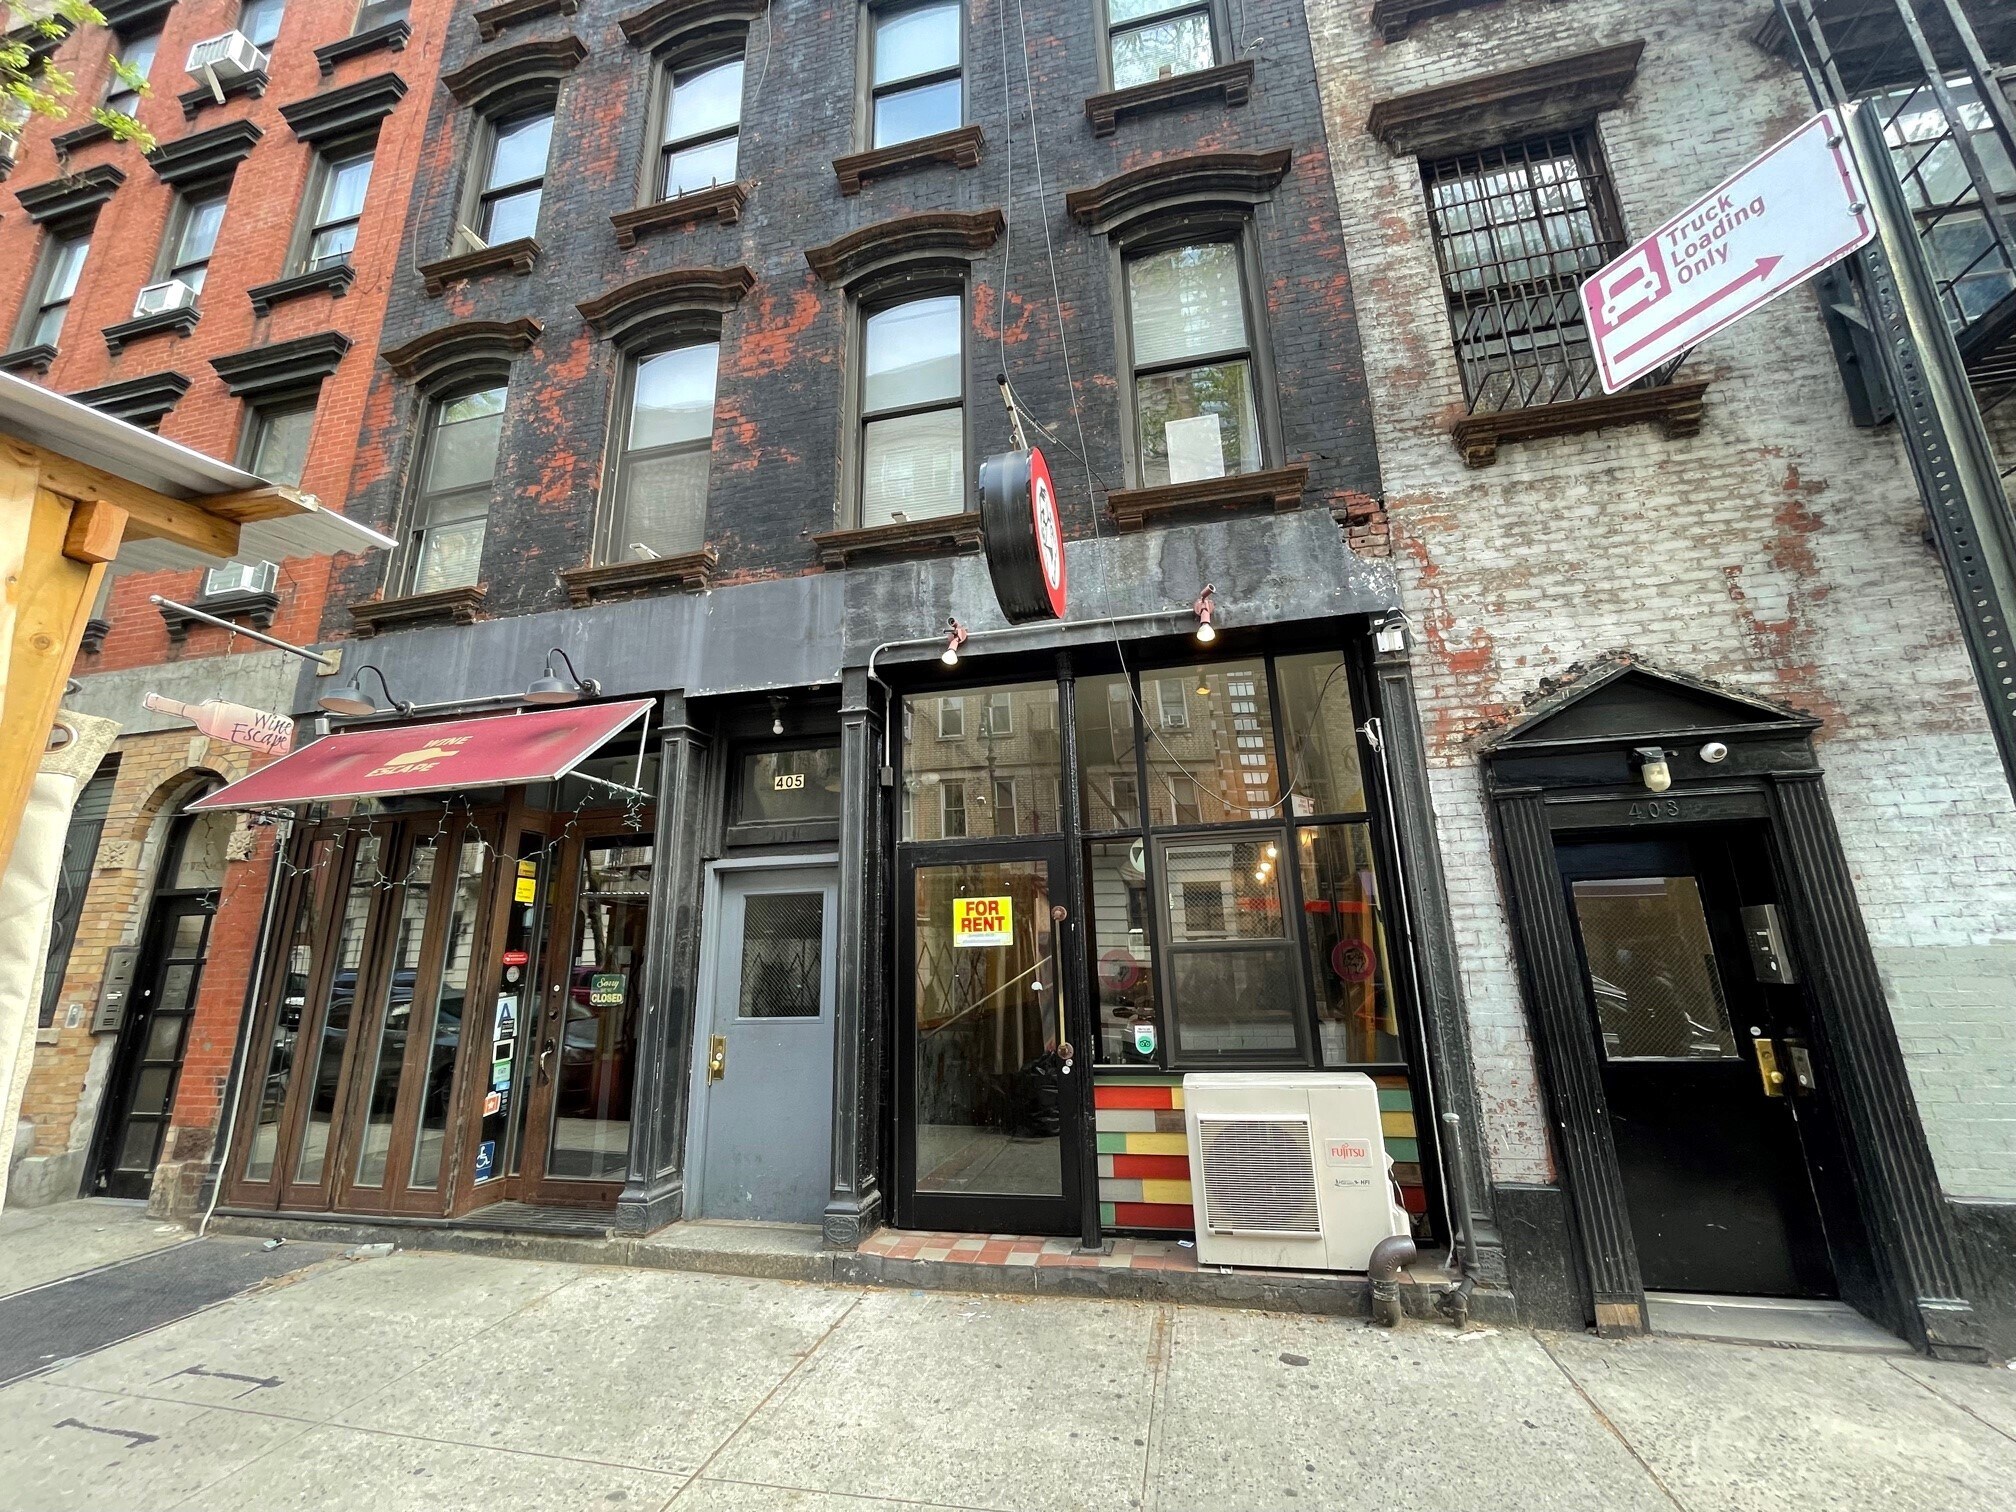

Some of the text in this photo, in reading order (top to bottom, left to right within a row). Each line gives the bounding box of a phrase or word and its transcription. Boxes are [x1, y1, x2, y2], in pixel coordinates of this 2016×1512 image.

[1665, 195, 1734, 248] Truck
[1669, 195, 1766, 268] Loading
[1677, 242, 1729, 285] Only
[254, 712, 292, 735] Wine
[231, 722, 288, 754] Escape
[422, 735, 474, 749] WINE
[363, 761, 441, 778] ESCAPE
[775, 775, 803, 789] 405
[1628, 800, 1679, 818] 403
[965, 900, 1000, 916] FOR
[961, 916, 1006, 933] RENT
[596, 977, 620, 991] Sorry
[591, 993, 623, 1003] CLOSED
[1331, 1142, 1365, 1159] FUJITSU
